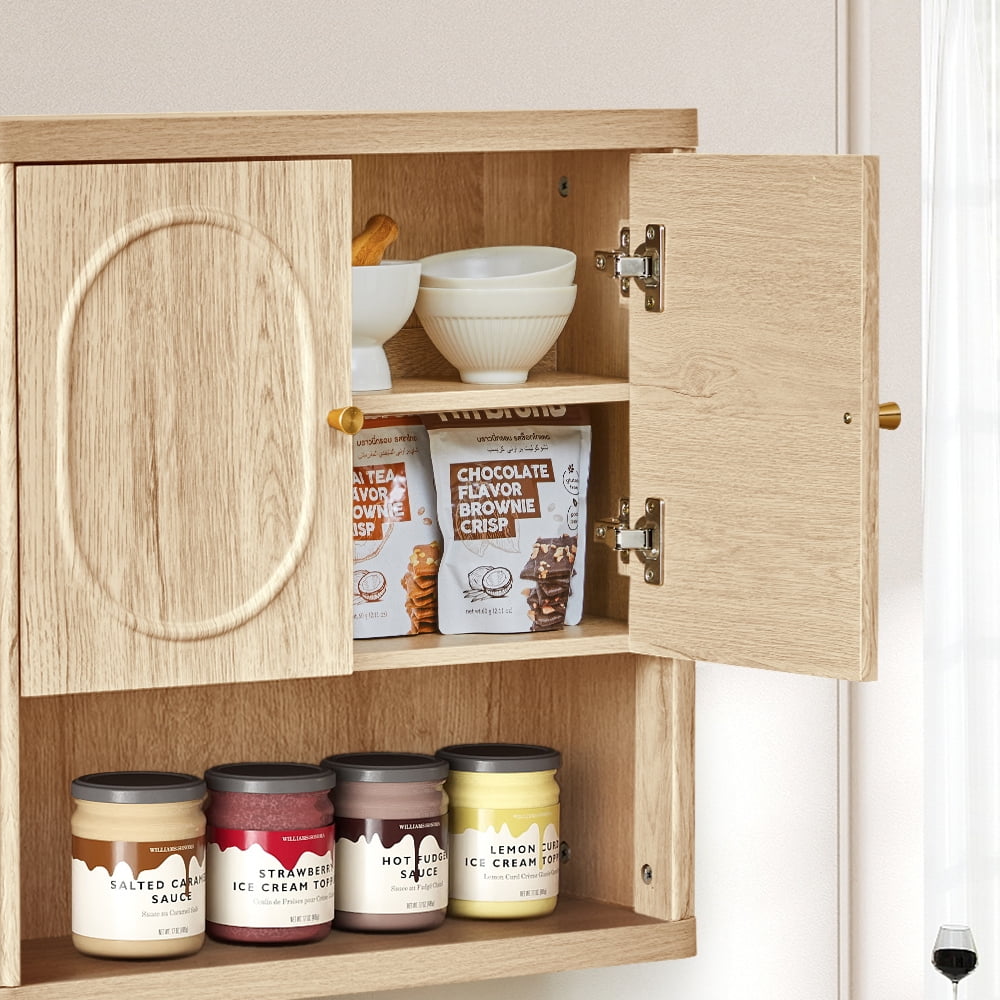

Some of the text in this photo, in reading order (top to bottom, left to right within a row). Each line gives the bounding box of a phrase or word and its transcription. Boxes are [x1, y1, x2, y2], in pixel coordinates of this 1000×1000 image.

[353, 468, 395, 485] AI TEA
[457, 464, 550, 482] CHOCOLATE
[353, 486, 388, 502] AVOR
[458, 482, 522, 500] FLAVOR
[353, 501, 405, 519] OWNIE
[459, 498, 536, 517] BROWNIE
[353, 521, 376, 537] ISP
[461, 518, 509, 534] CRISP
[490, 844, 536, 855] LEMON
[382, 856, 411, 866] HOT
[465, 857, 486, 867] ICE
[492, 857, 537, 868] CREAM
[400, 866, 438, 879] SAUCE
[110, 880, 165, 890] SALTED
[233, 881, 254, 891] ICE
[261, 882, 308, 892] CREAM
[152, 891, 192, 904] SAUCE
